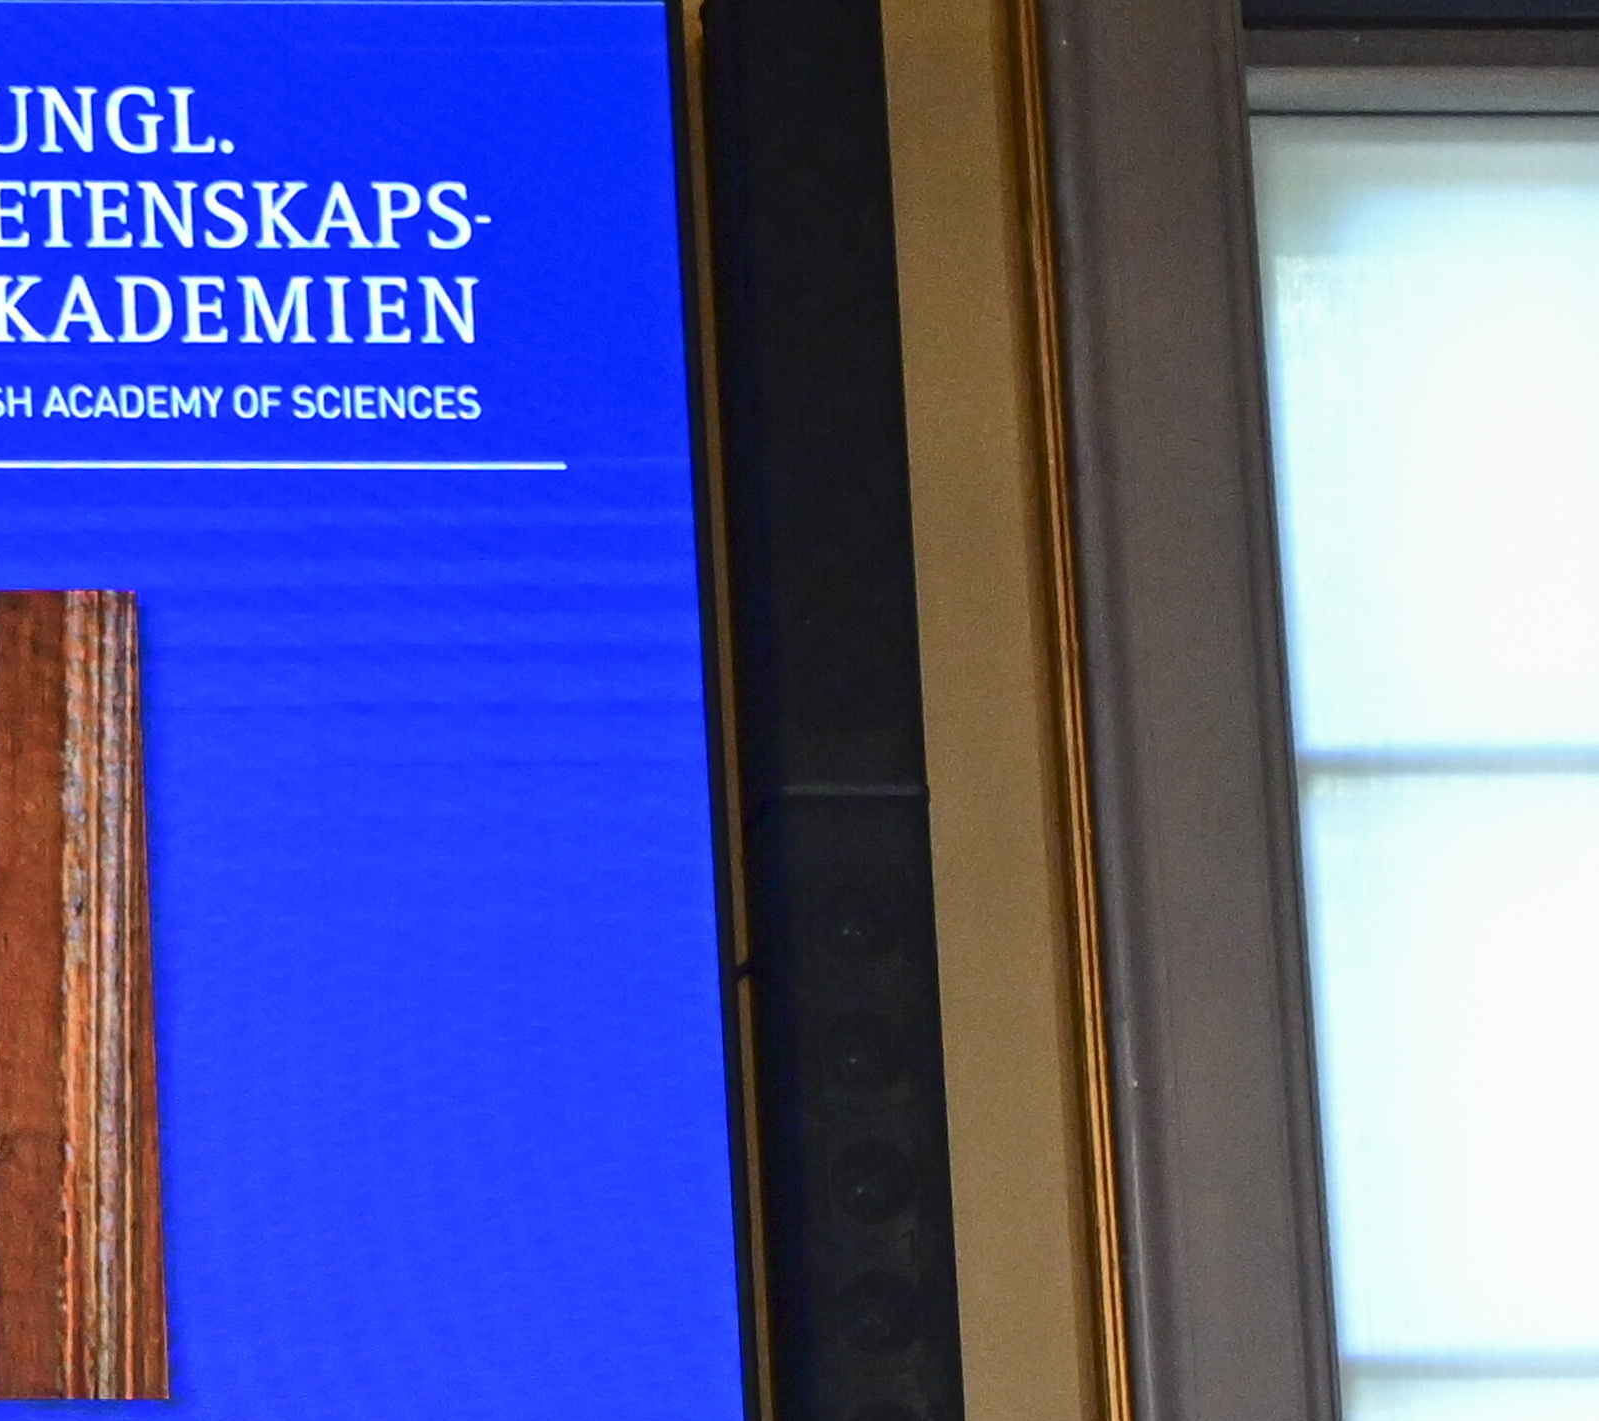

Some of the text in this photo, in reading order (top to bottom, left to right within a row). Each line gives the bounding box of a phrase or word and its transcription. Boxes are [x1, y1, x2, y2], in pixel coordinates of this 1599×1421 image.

[42, 383, 225, 420] ACADEMY
[232, 383, 283, 420] OF
[290, 383, 483, 421] SCIENCES
